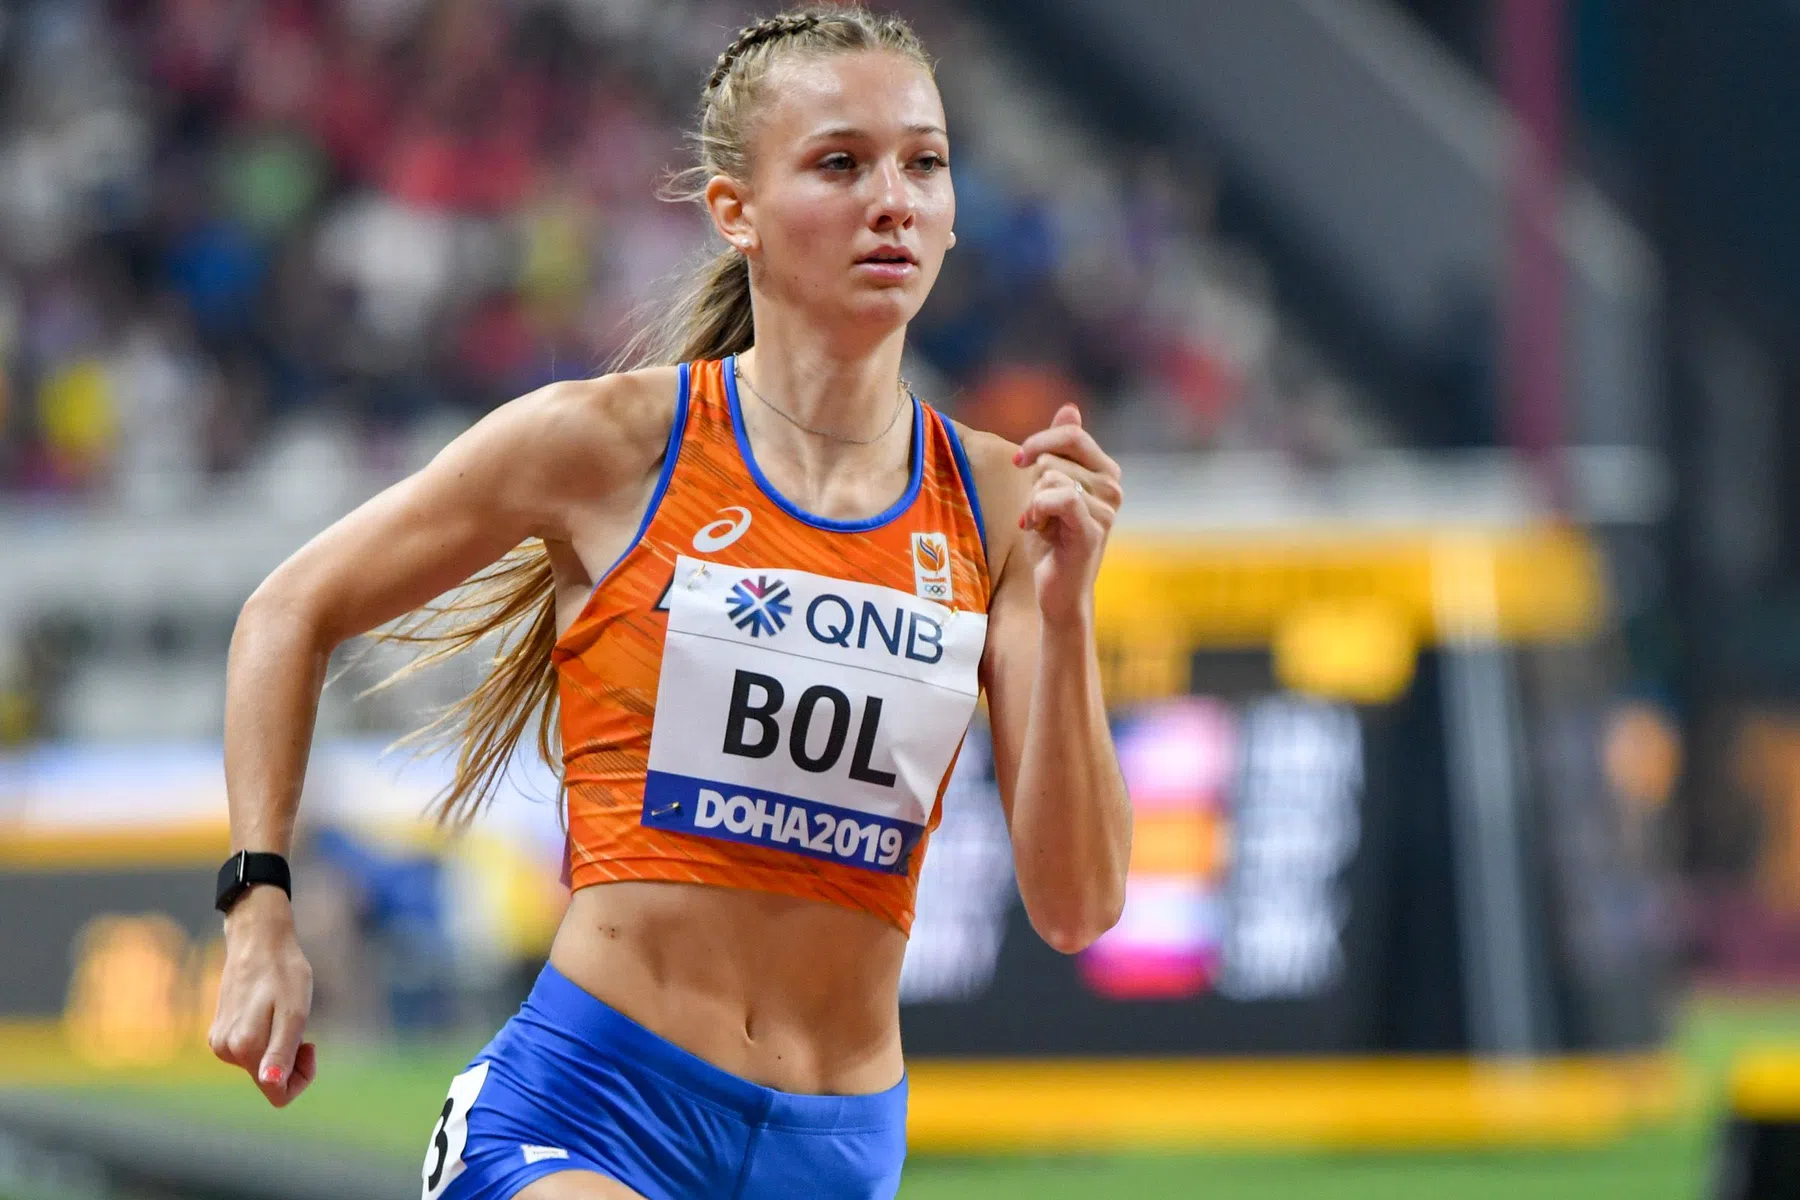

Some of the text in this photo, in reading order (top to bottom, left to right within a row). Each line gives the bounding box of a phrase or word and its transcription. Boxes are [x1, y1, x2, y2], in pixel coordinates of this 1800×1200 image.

[805, 594, 944, 664] QNB
[722, 669, 897, 788] BOL
[694, 789, 903, 866] DOHA2019
[428, 1097, 454, 1192] 3
